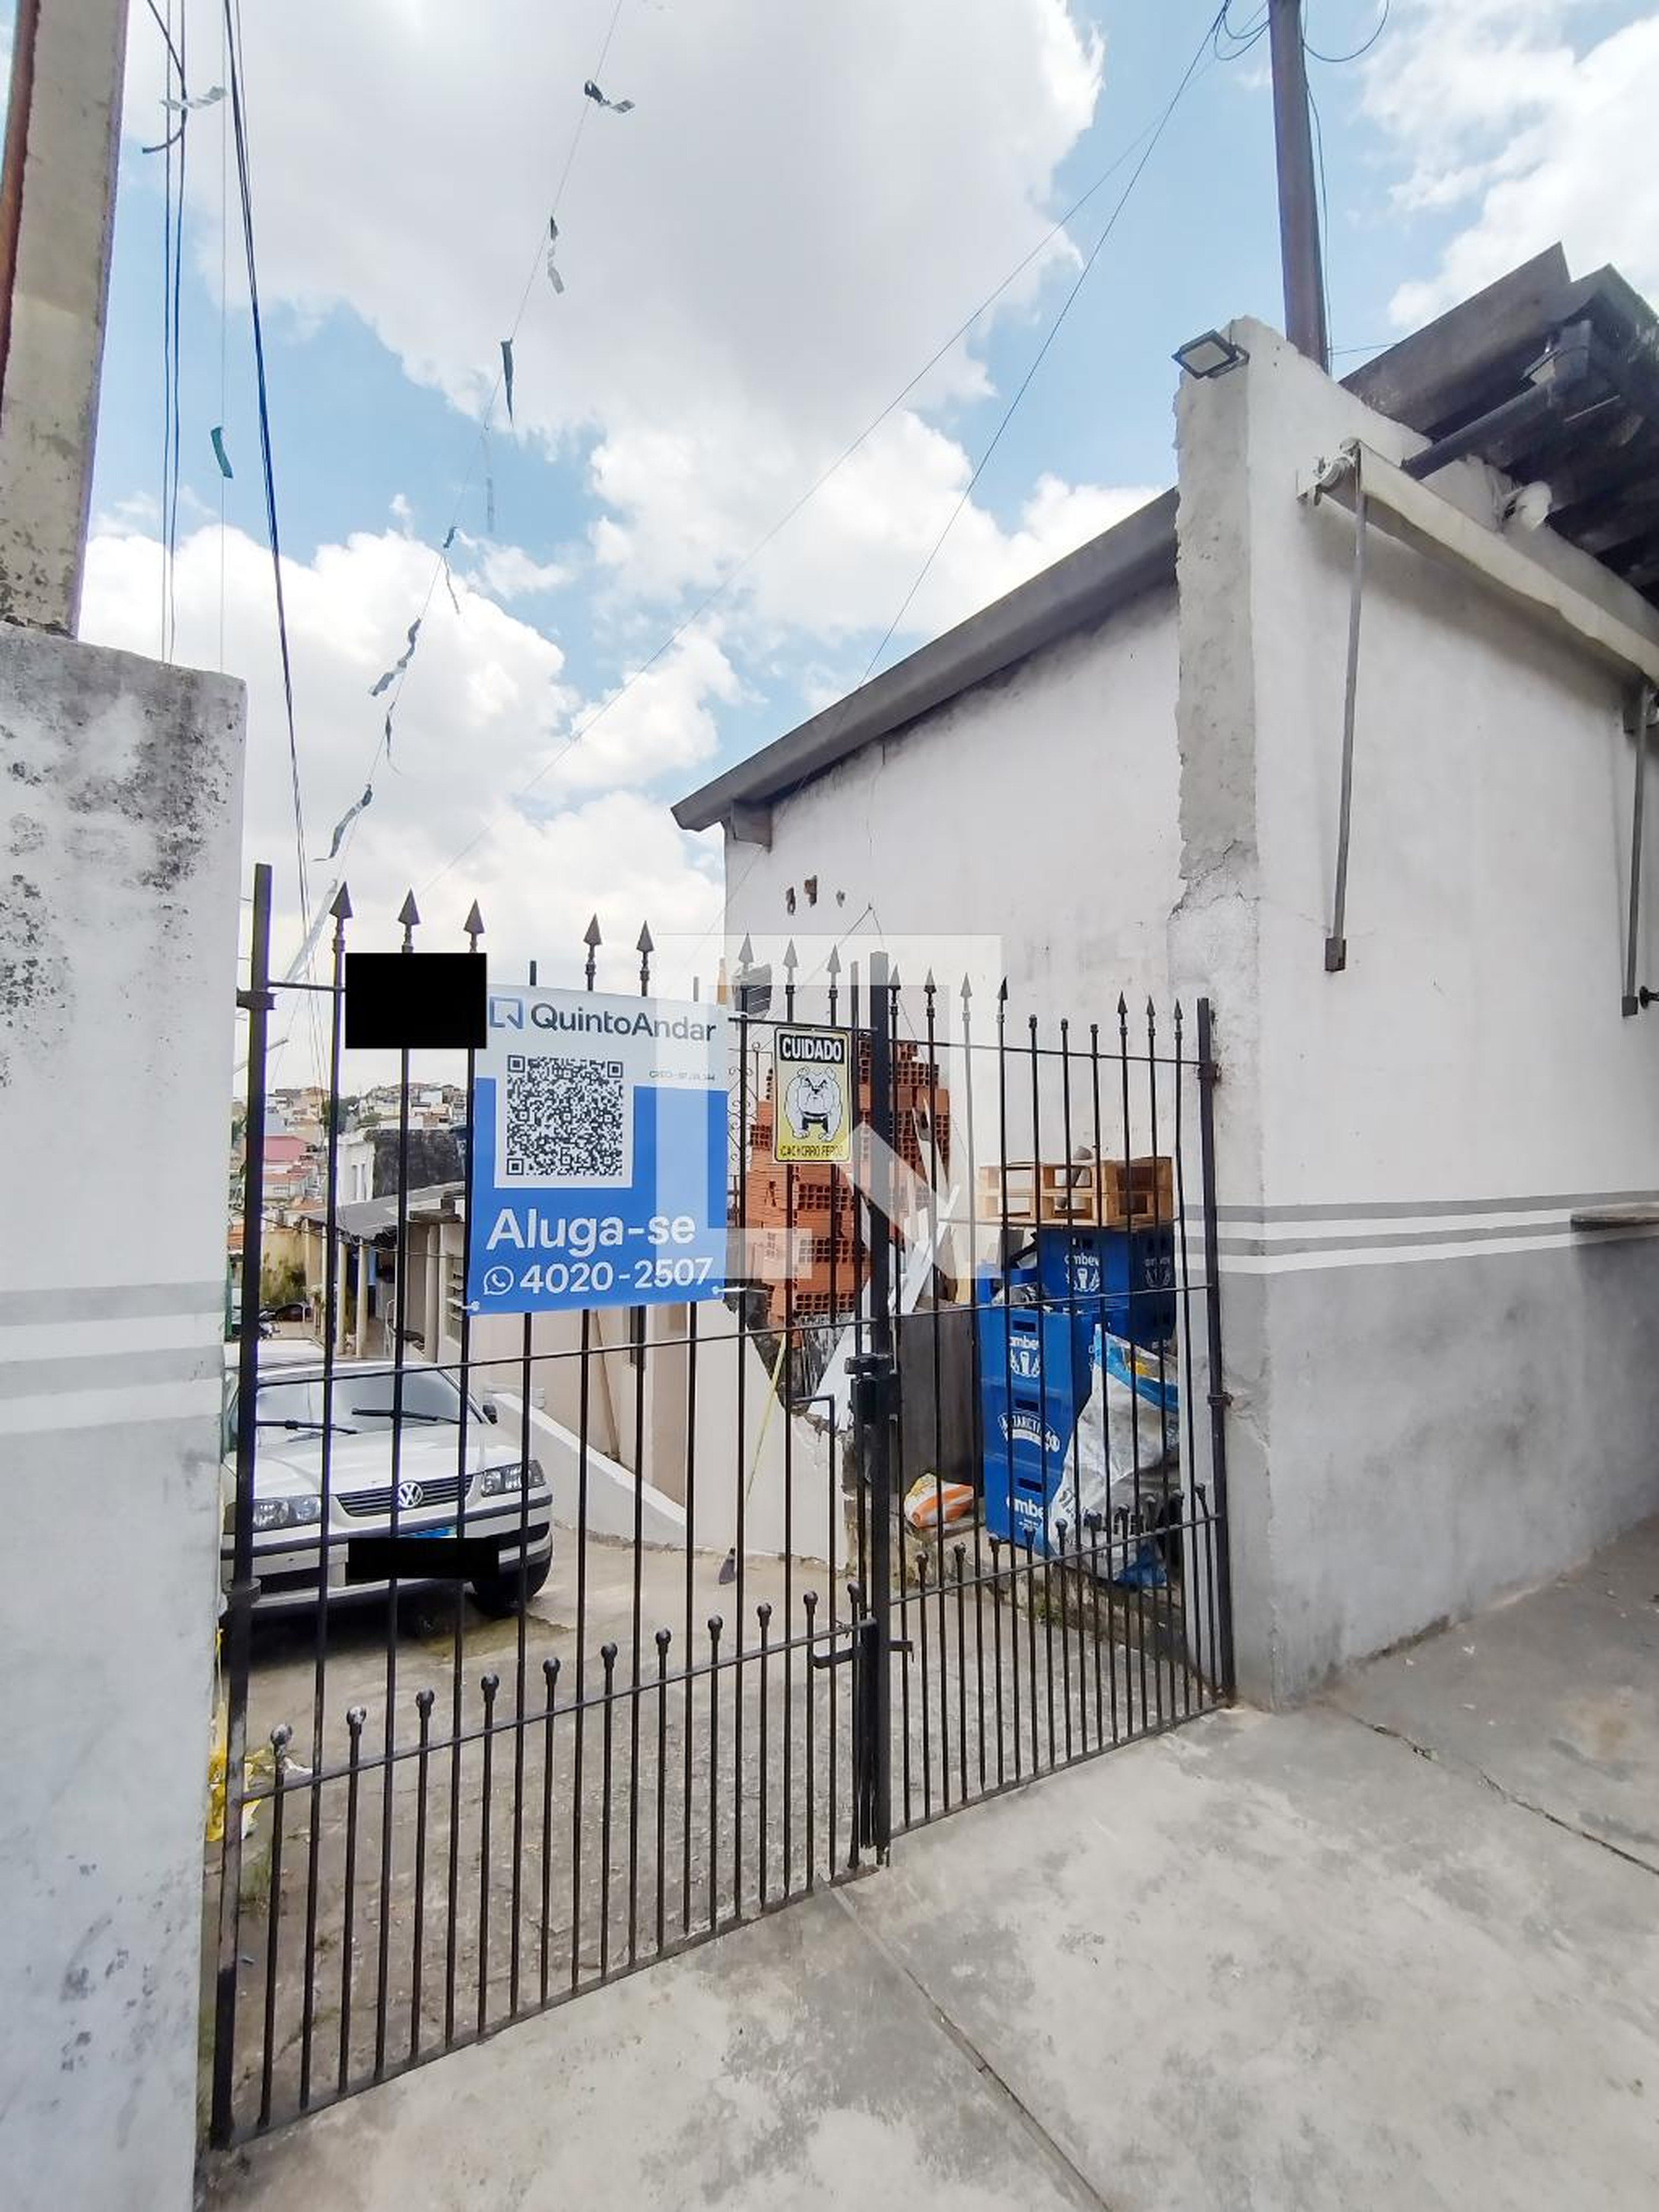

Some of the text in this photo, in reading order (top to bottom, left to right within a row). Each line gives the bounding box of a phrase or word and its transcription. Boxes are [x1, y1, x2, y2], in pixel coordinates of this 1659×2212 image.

[531, 1003, 716, 1041] QuintoAndar
[782, 1037, 842, 1062] CUIDADO
[486, 1208, 696, 1257] Aluga-se
